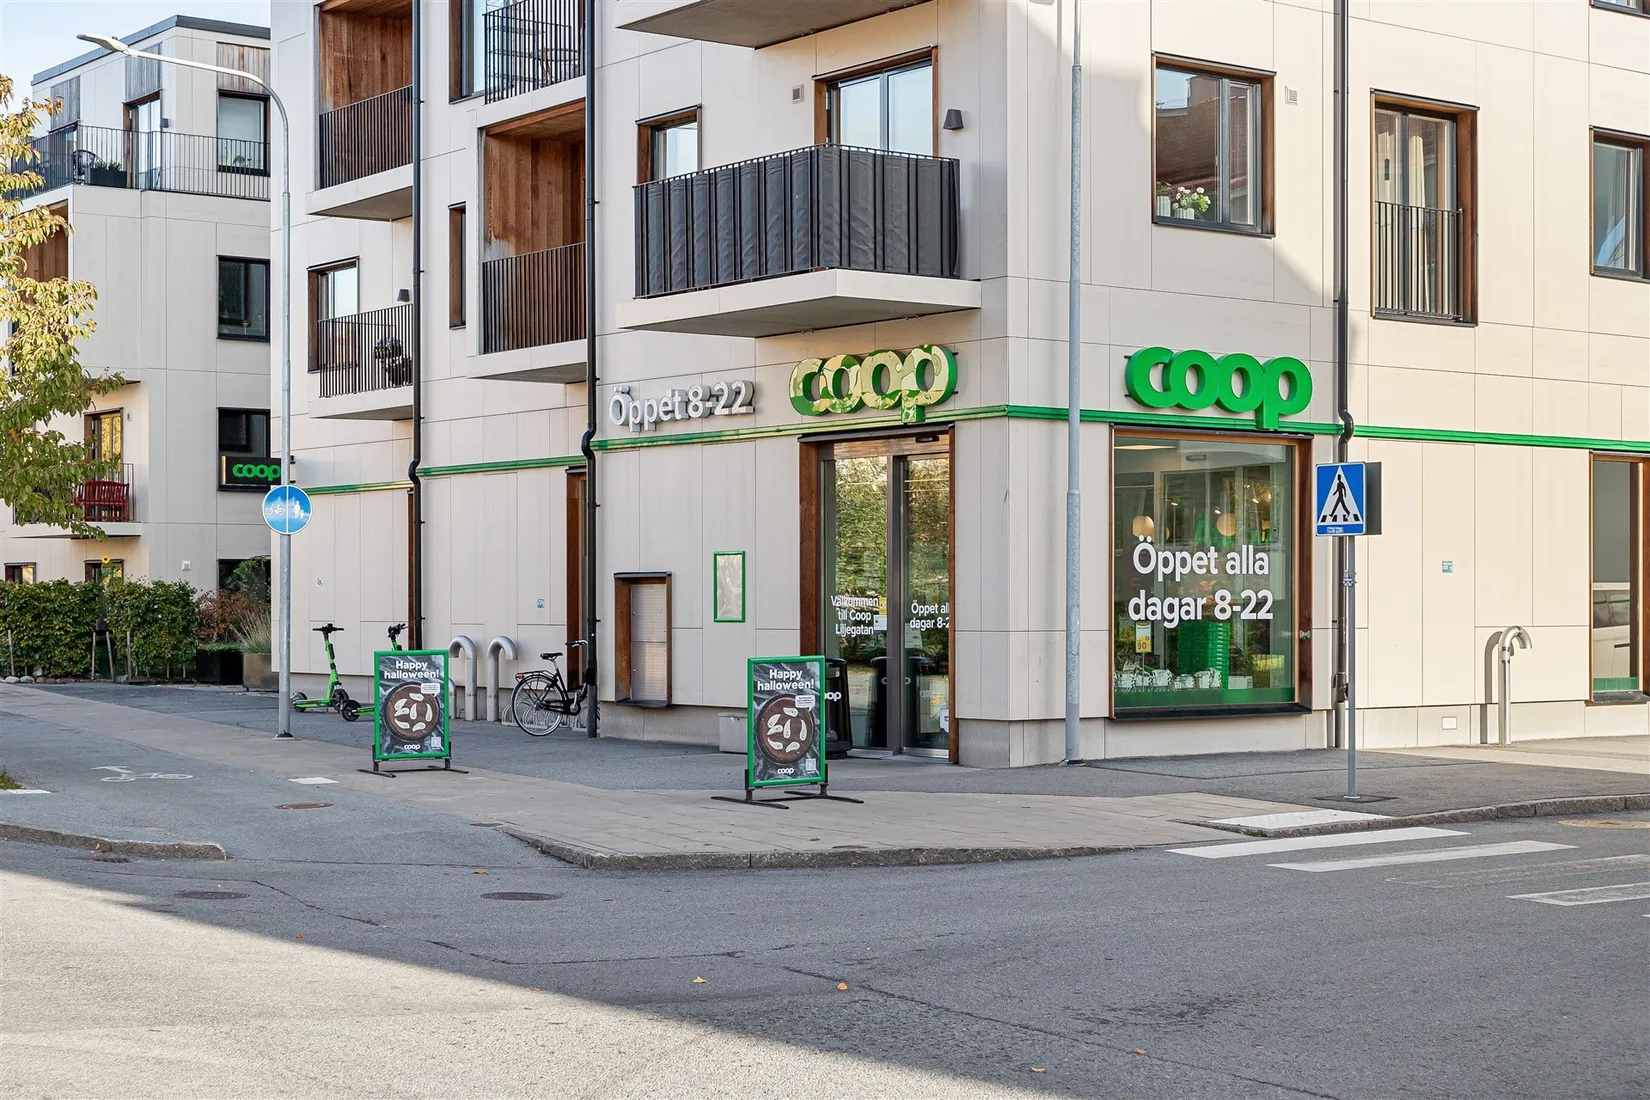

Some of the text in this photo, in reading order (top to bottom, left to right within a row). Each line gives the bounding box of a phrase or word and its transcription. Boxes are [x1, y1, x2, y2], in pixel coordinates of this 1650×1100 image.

[789, 343, 959, 424] coop
[1125, 346, 1313, 430] coop
[608, 380, 755, 432] Öppet 8-22
[232, 464, 281, 481] coop
[1132, 535, 1269, 582] Öppet alla
[831, 595, 879, 608] Välkommen
[911, 600, 939, 616] Öppet
[1127, 589, 1274, 629] dagar 8-22
[838, 609, 872, 624] till Coop
[835, 623, 874, 637] Liljegatan
[909, 617, 935, 631] dagar
[395, 660, 428, 671] Happy
[384, 670, 440, 680] halloween!
[769, 669, 803, 681] Happy
[757, 679, 815, 691] halloween!
[777, 767, 795, 775] coop
